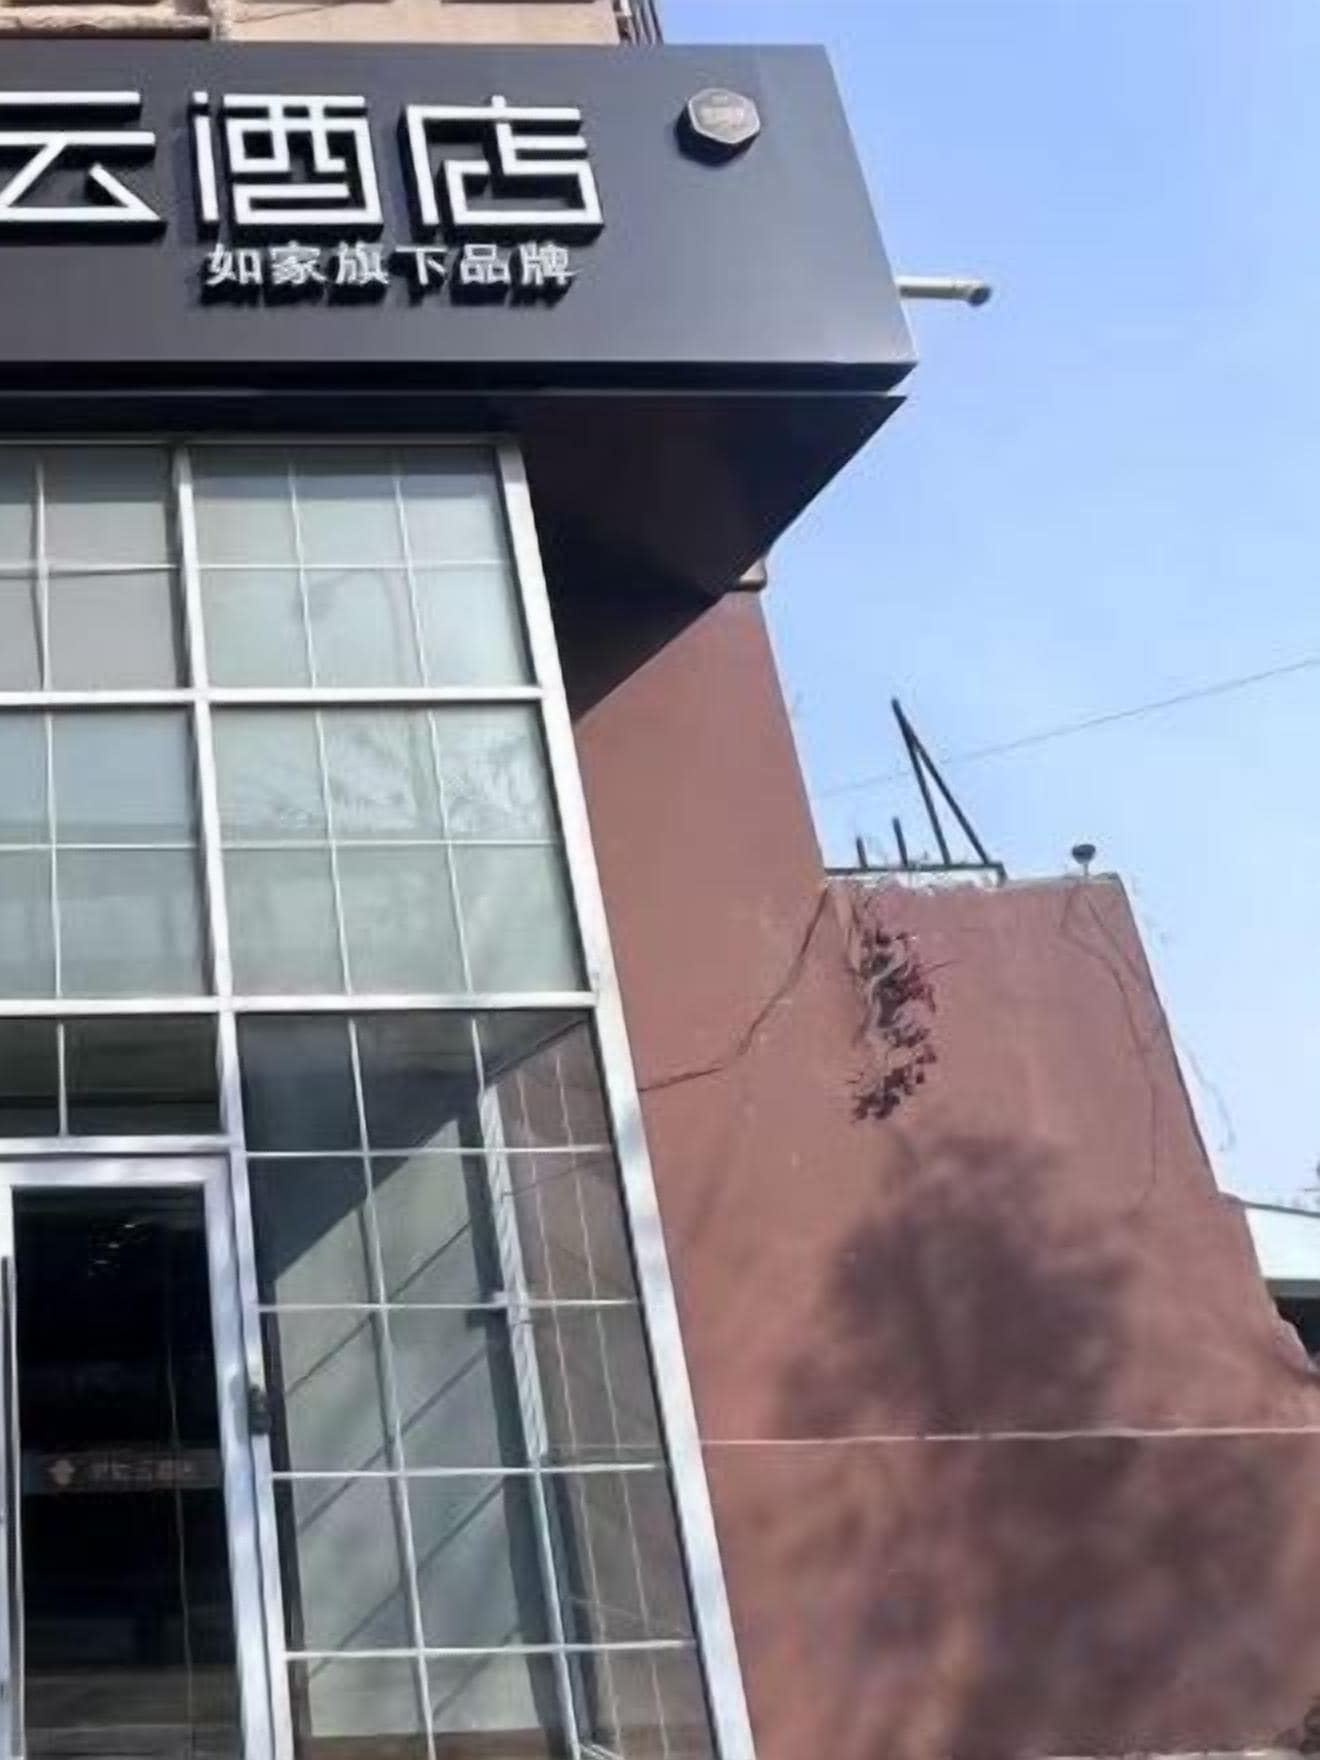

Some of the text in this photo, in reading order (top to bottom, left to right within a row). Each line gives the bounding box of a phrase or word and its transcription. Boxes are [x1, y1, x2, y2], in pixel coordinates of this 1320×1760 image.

[205, 241, 577, 286] 如家旗下品牌
